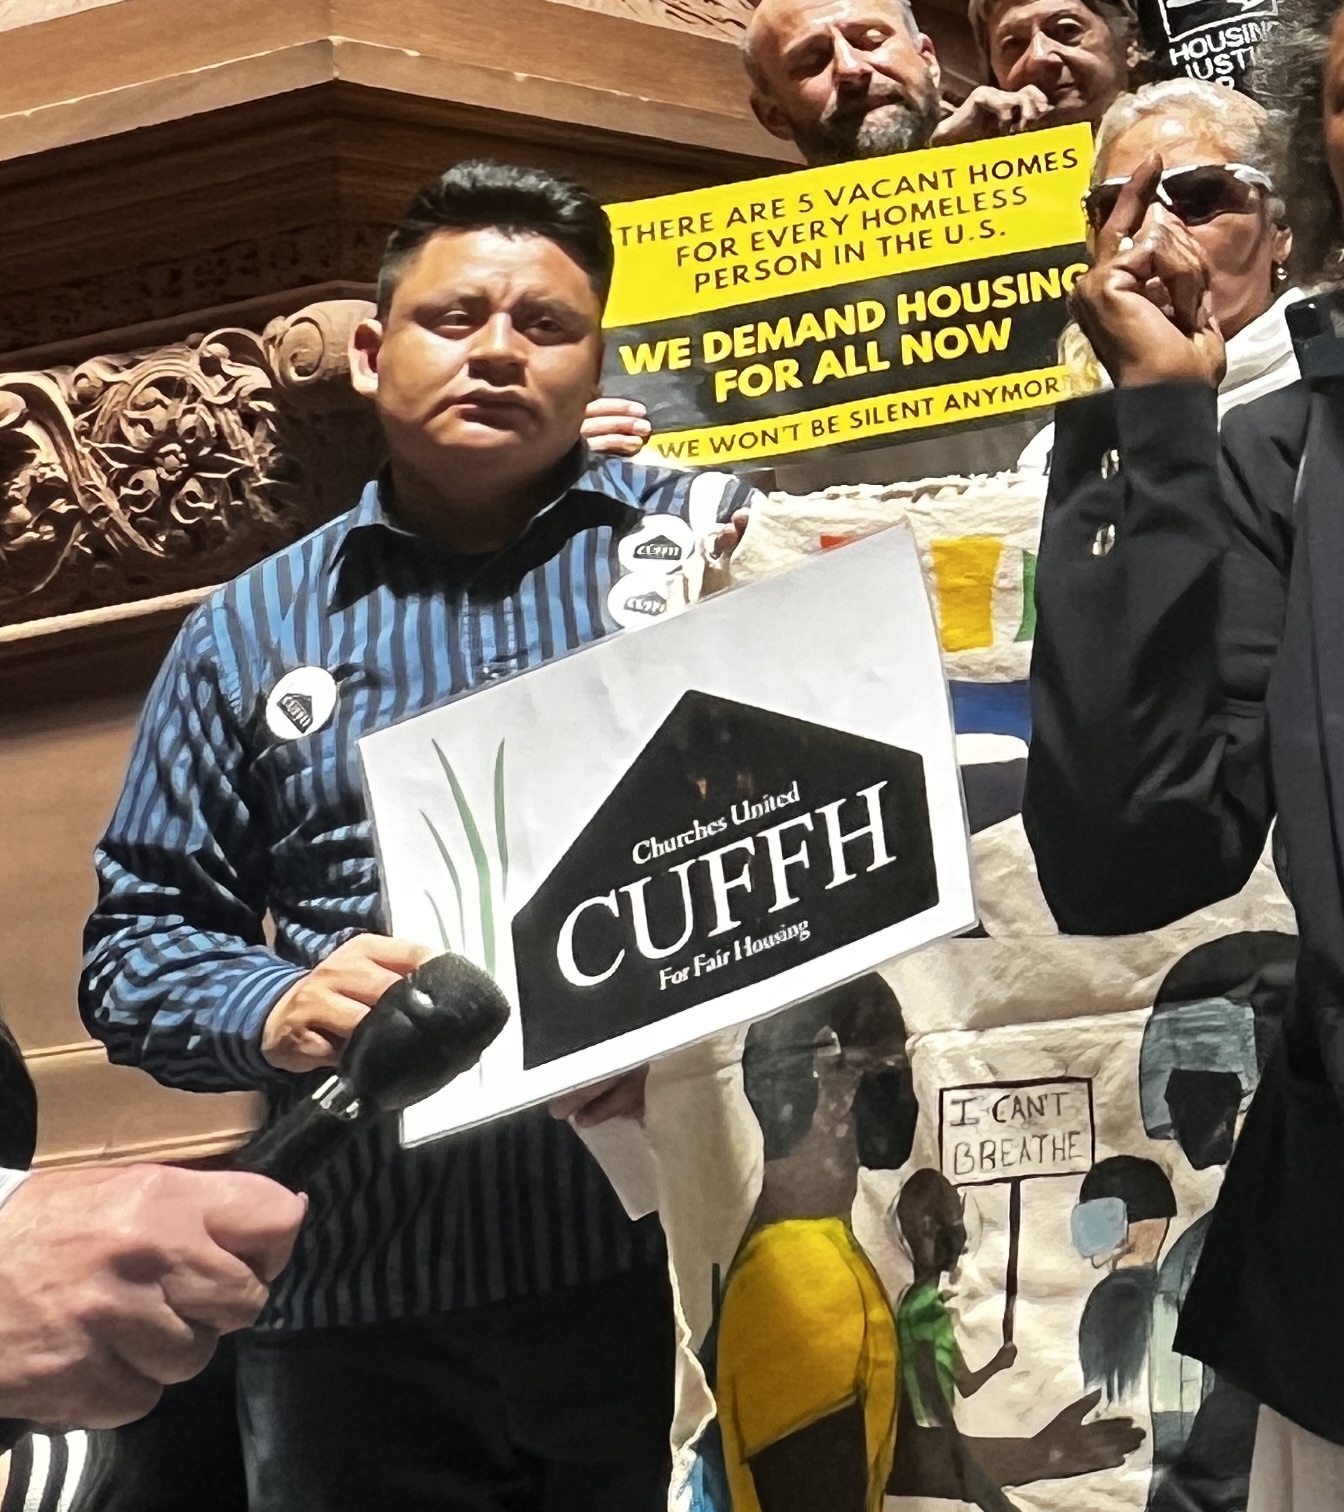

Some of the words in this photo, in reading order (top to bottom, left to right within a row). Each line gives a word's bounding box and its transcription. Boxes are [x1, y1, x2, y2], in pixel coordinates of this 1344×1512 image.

[1169, 20, 1272, 66] HOUSIN
[617, 210, 714, 248] THERE
[726, 199, 786, 230] ARE
[798, 193, 814, 214] 5
[824, 168, 957, 209] VACANT
[969, 147, 1080, 186] HOMES
[677, 236, 739, 267] FOR
[750, 215, 850, 254] EVERY
[862, 185, 1029, 231] HOMELESS
[695, 253, 823, 294] PERSON
[834, 242, 865, 267] IN
[877, 229, 935, 260] THE
[945, 219, 1008, 246] U.S.
[619, 336, 692, 376] WE
[703, 299, 886, 364] DEMAND
[714, 358, 803, 403] FOR
[812, 343, 891, 386] ALL
[902, 316, 1013, 368] NOW
[657, 436, 700, 460] WE
[708, 421, 802, 456] WON'T
[812, 417, 841, 439] BE
[849, 398, 934, 430] SILENT
[944, 375, 1061, 413] ANYMOR
[631, 816, 729, 867] Churches
[730, 780, 802, 828] United
[555, 780, 899, 989] CUFFH
[659, 962, 692, 992] For
[692, 947, 733, 984] Fair
[733, 917, 812, 962] Housing
[951, 1098, 980, 1126] I
[991, 1090, 1070, 1125] CAN'T
[953, 1129, 1086, 1176] BREATHE
